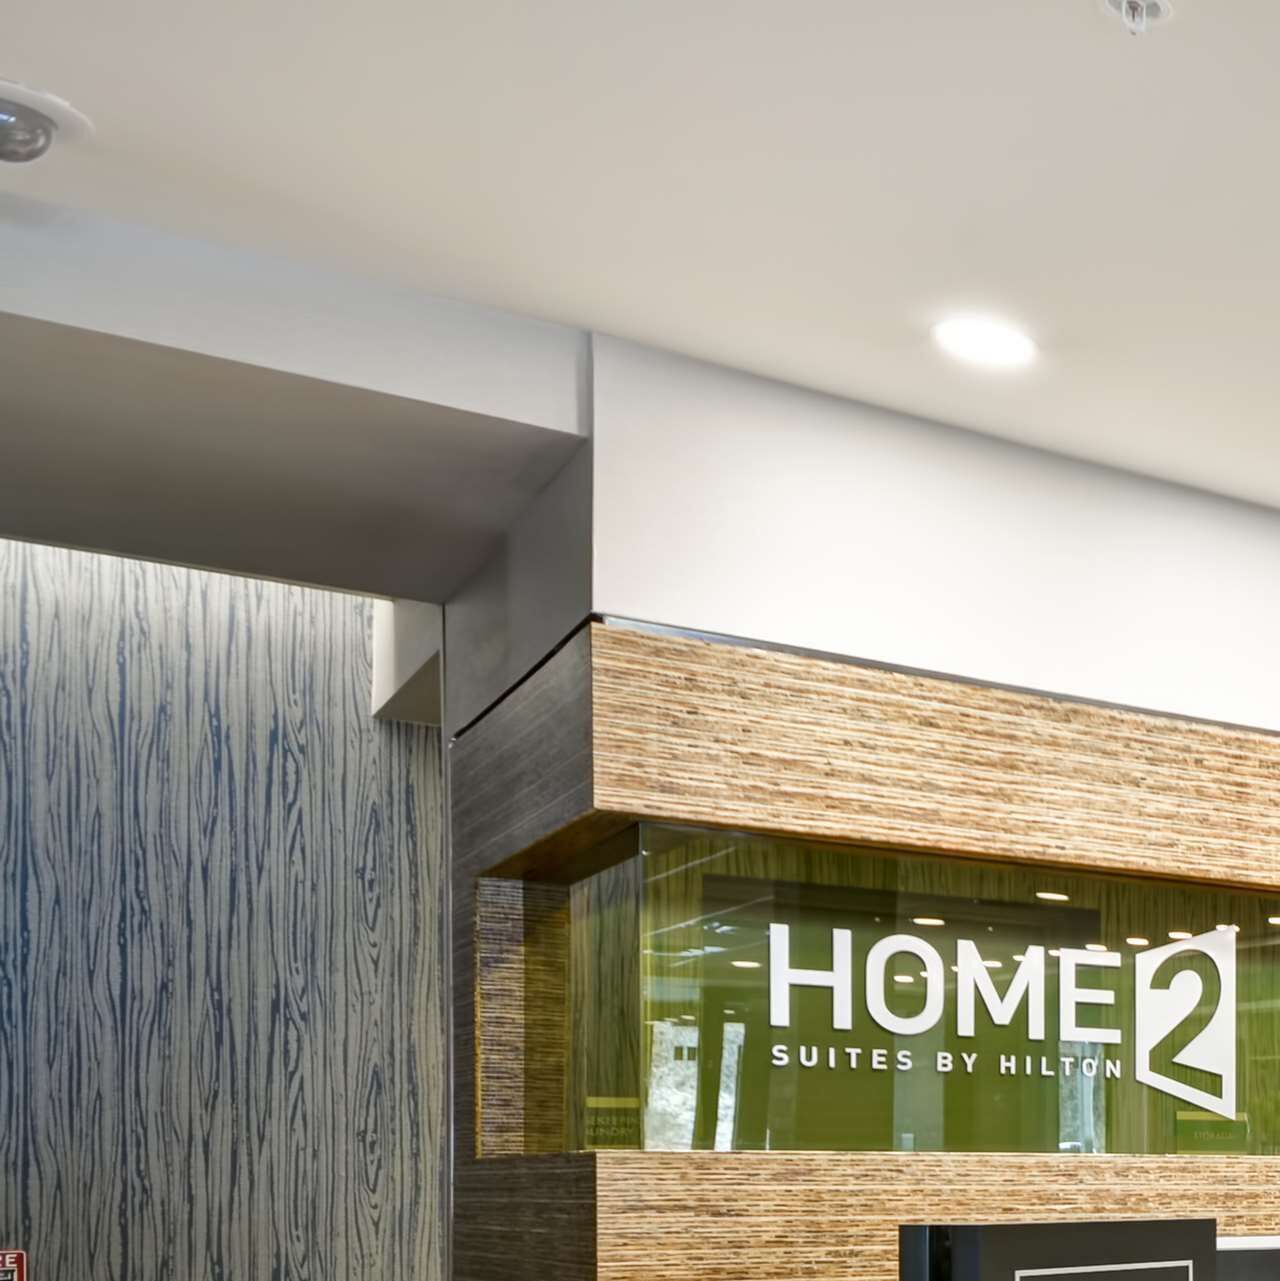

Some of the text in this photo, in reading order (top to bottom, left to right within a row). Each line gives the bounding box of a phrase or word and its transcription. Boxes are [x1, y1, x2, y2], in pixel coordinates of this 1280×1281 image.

[771, 1044, 1121, 1079] SUITES BY HILTON
